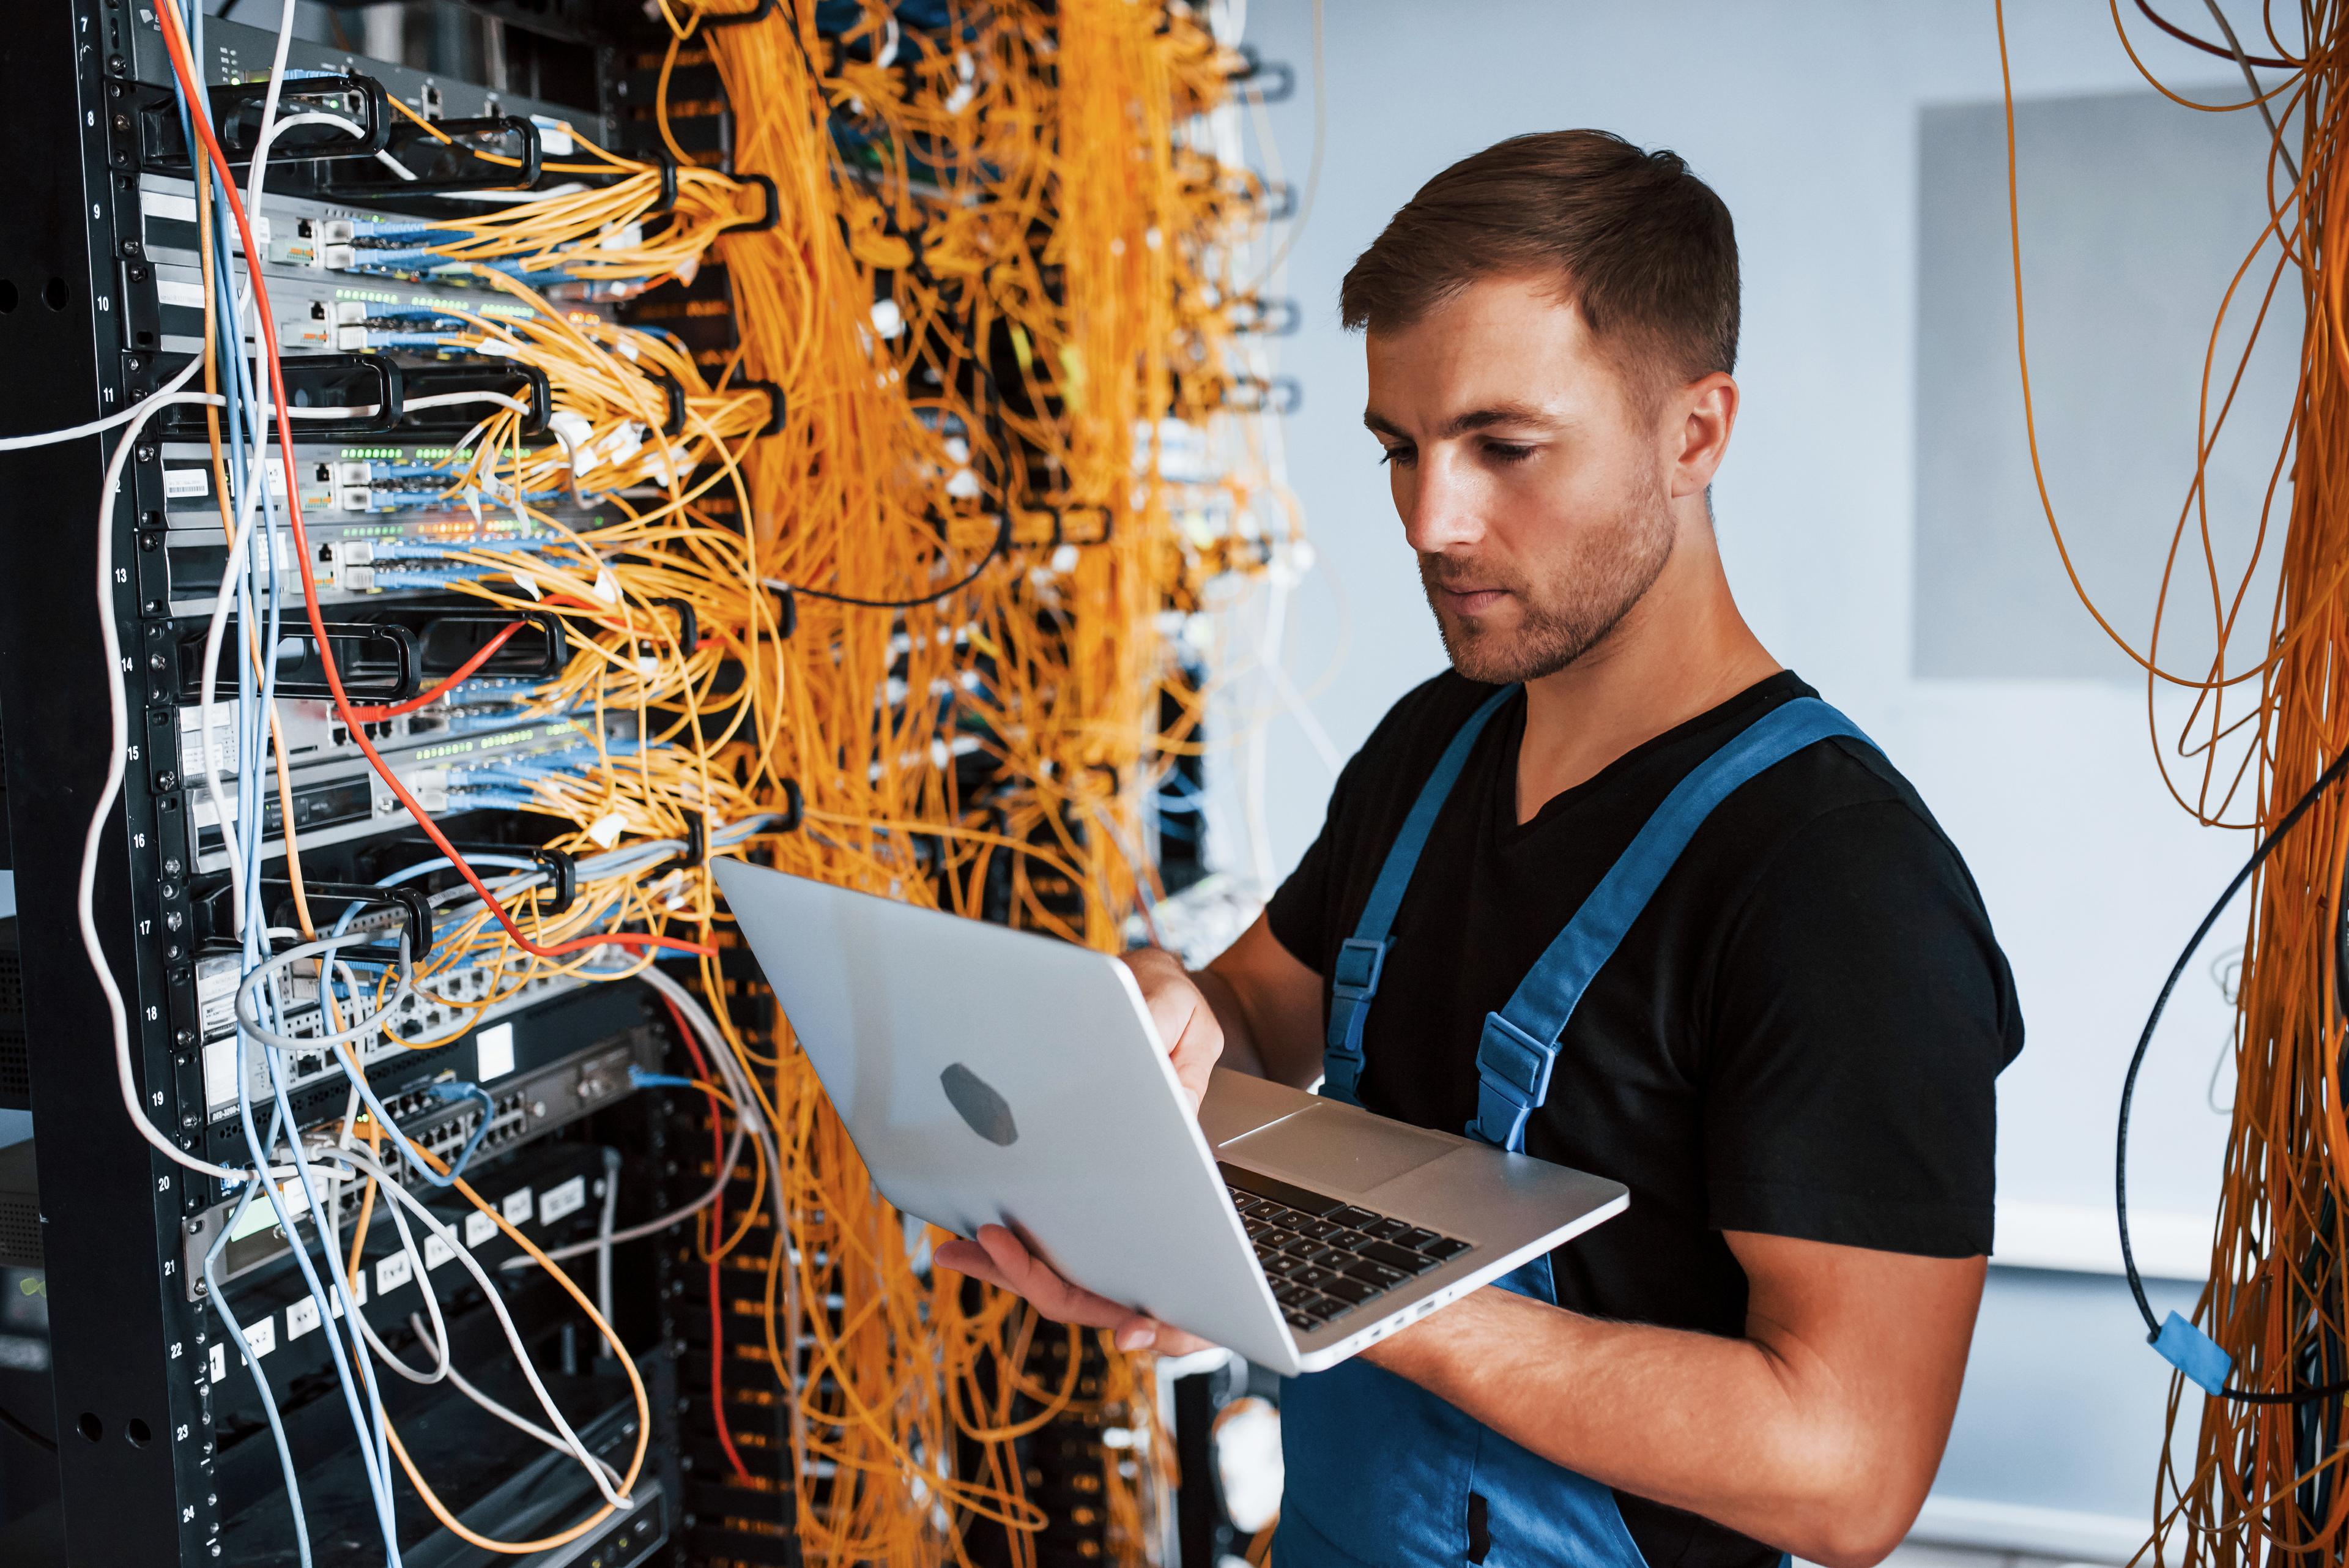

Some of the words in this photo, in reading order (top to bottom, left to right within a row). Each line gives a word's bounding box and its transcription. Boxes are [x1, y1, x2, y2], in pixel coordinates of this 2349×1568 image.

[81, 17, 88, 32] 7
[87, 111, 94, 126] 8
[94, 204, 100, 219] 9
[97, 296, 109, 311] 10
[103, 388, 114, 402] 11
[115, 568, 127, 583] 13
[122, 657, 133, 672] 14
[128, 746, 139, 760] 15
[133, 834, 146, 849] 16
[139, 920, 151, 935] 17
[146, 1006, 157, 1021] 18
[152, 1091, 164, 1107] 19
[158, 1176, 171, 1192] 20
[164, 1260, 176, 1276] 21
[170, 1342, 182, 1359] 22
[177, 1424, 189, 1441] 23
[183, 1506, 195, 1523] 24
